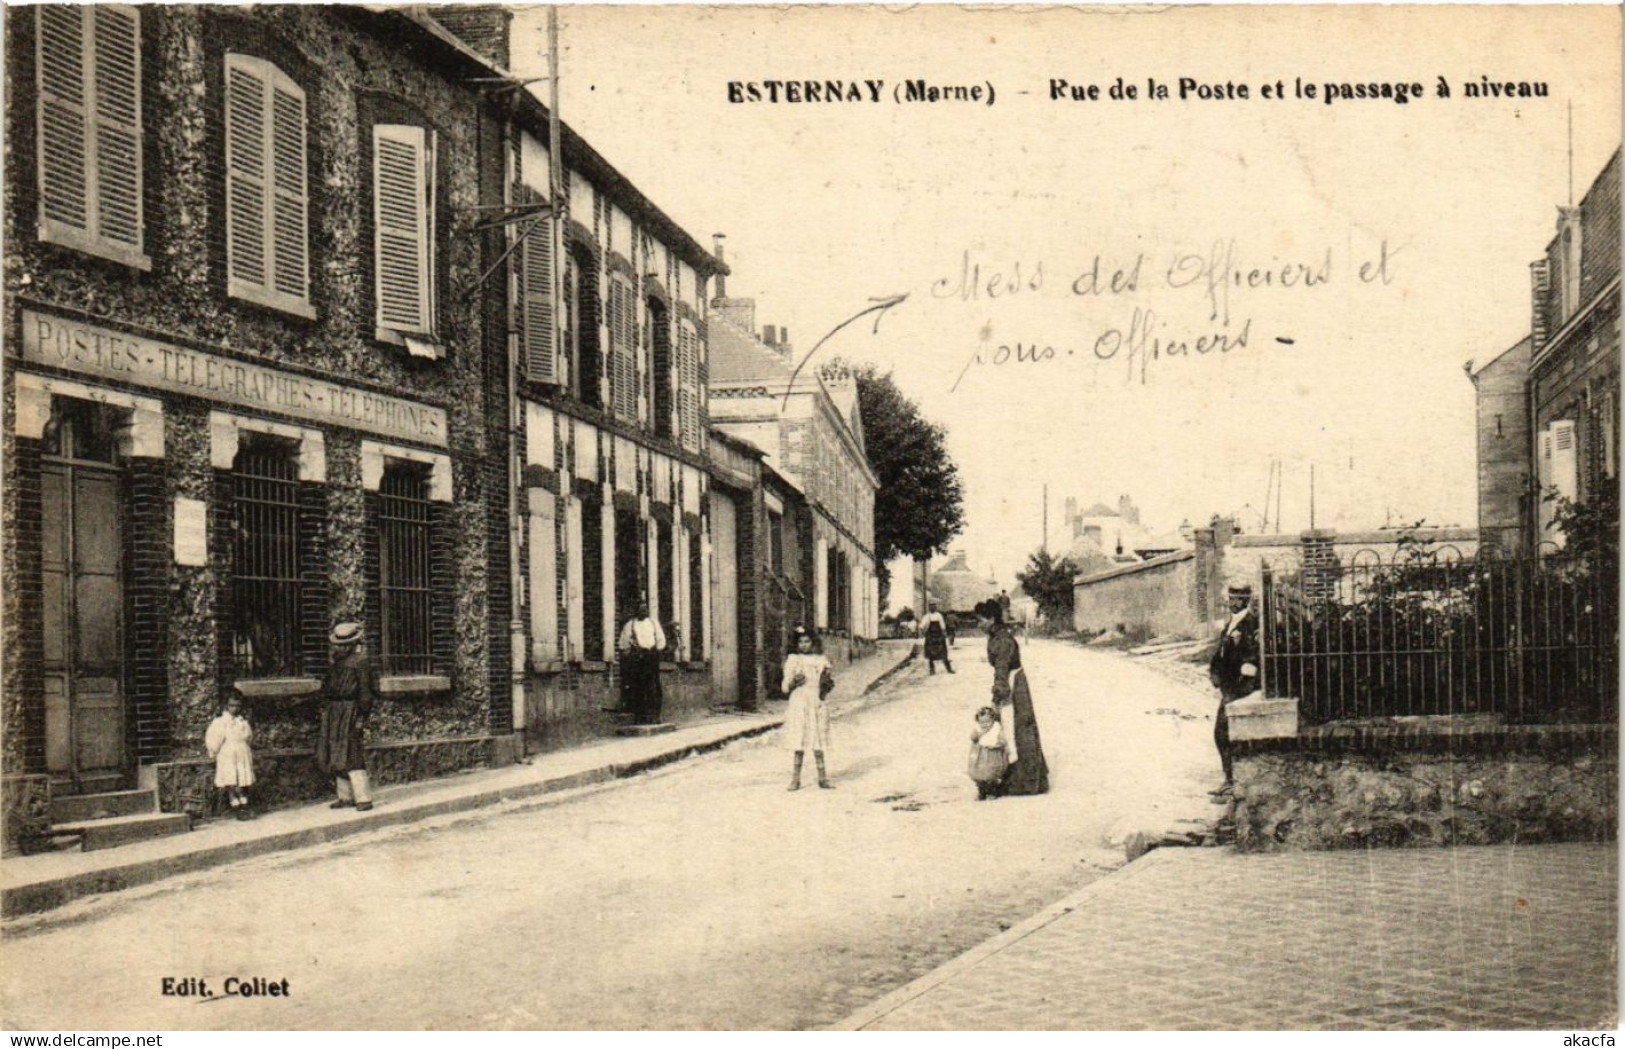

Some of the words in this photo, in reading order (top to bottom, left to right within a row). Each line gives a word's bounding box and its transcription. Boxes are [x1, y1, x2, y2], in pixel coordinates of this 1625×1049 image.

[931, 247, 1044, 302] Mess
[1072, 254, 1144, 297] des
[1165, 238, 1332, 323] Officiers
[1358, 239, 1408, 286] et
[35, 319, 140, 373] POSTES
